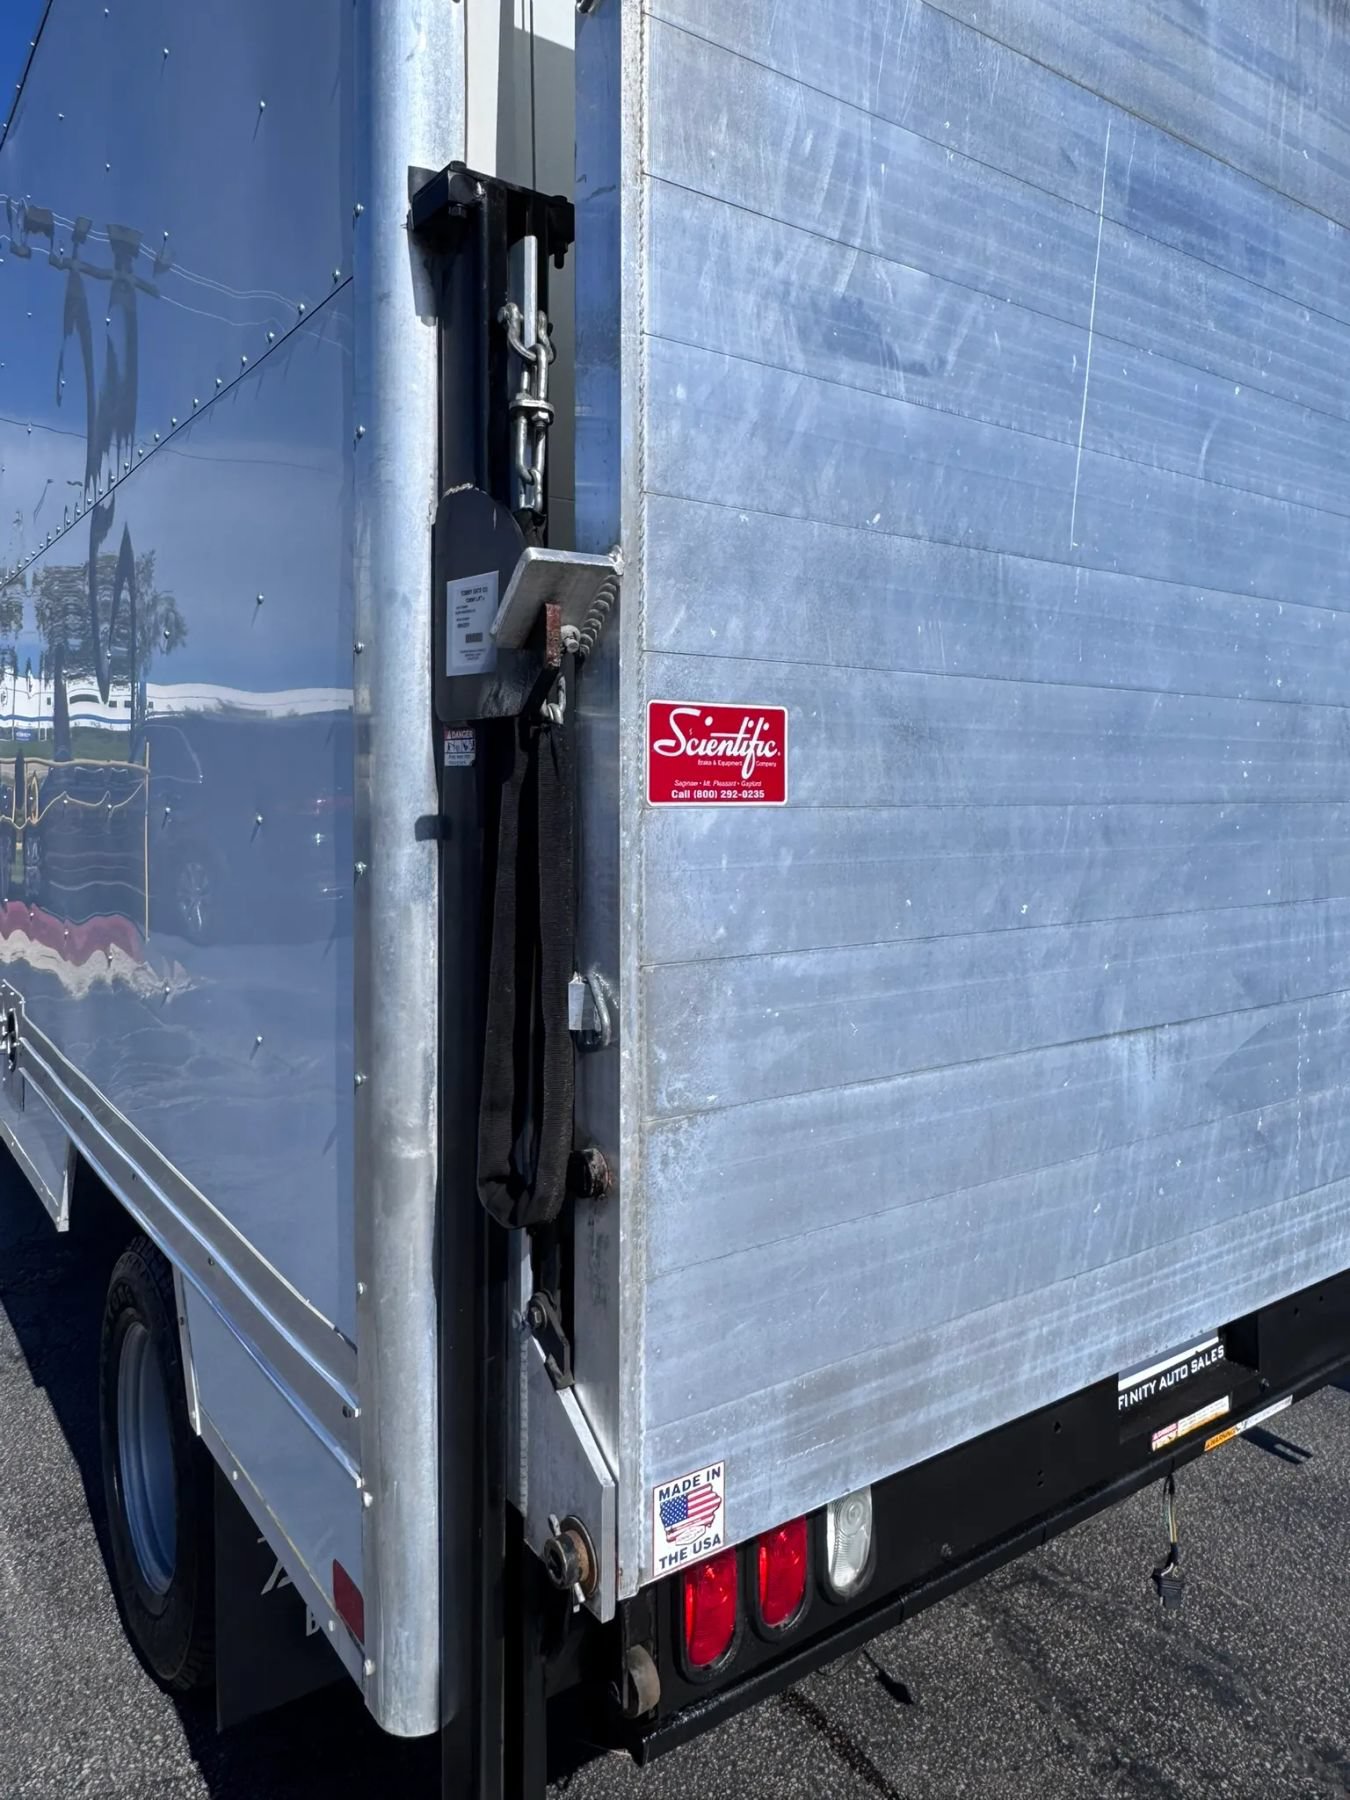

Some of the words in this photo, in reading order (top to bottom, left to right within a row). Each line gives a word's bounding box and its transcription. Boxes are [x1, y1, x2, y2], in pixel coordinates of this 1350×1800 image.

[653, 707, 778, 779] Scientific
[671, 790, 690, 799] Call
[693, 789, 718, 799] (800)
[720, 789, 765, 799] 292-0235
[1117, 1379, 1157, 1411] FINITY
[1158, 1365, 1189, 1391] AUTO
[1191, 1345, 1224, 1373] SALES
[659, 1474, 701, 1502] MADE
[706, 1466, 721, 1483] IN
[659, 1546, 688, 1570] THE
[692, 1533, 721, 1554] USA
